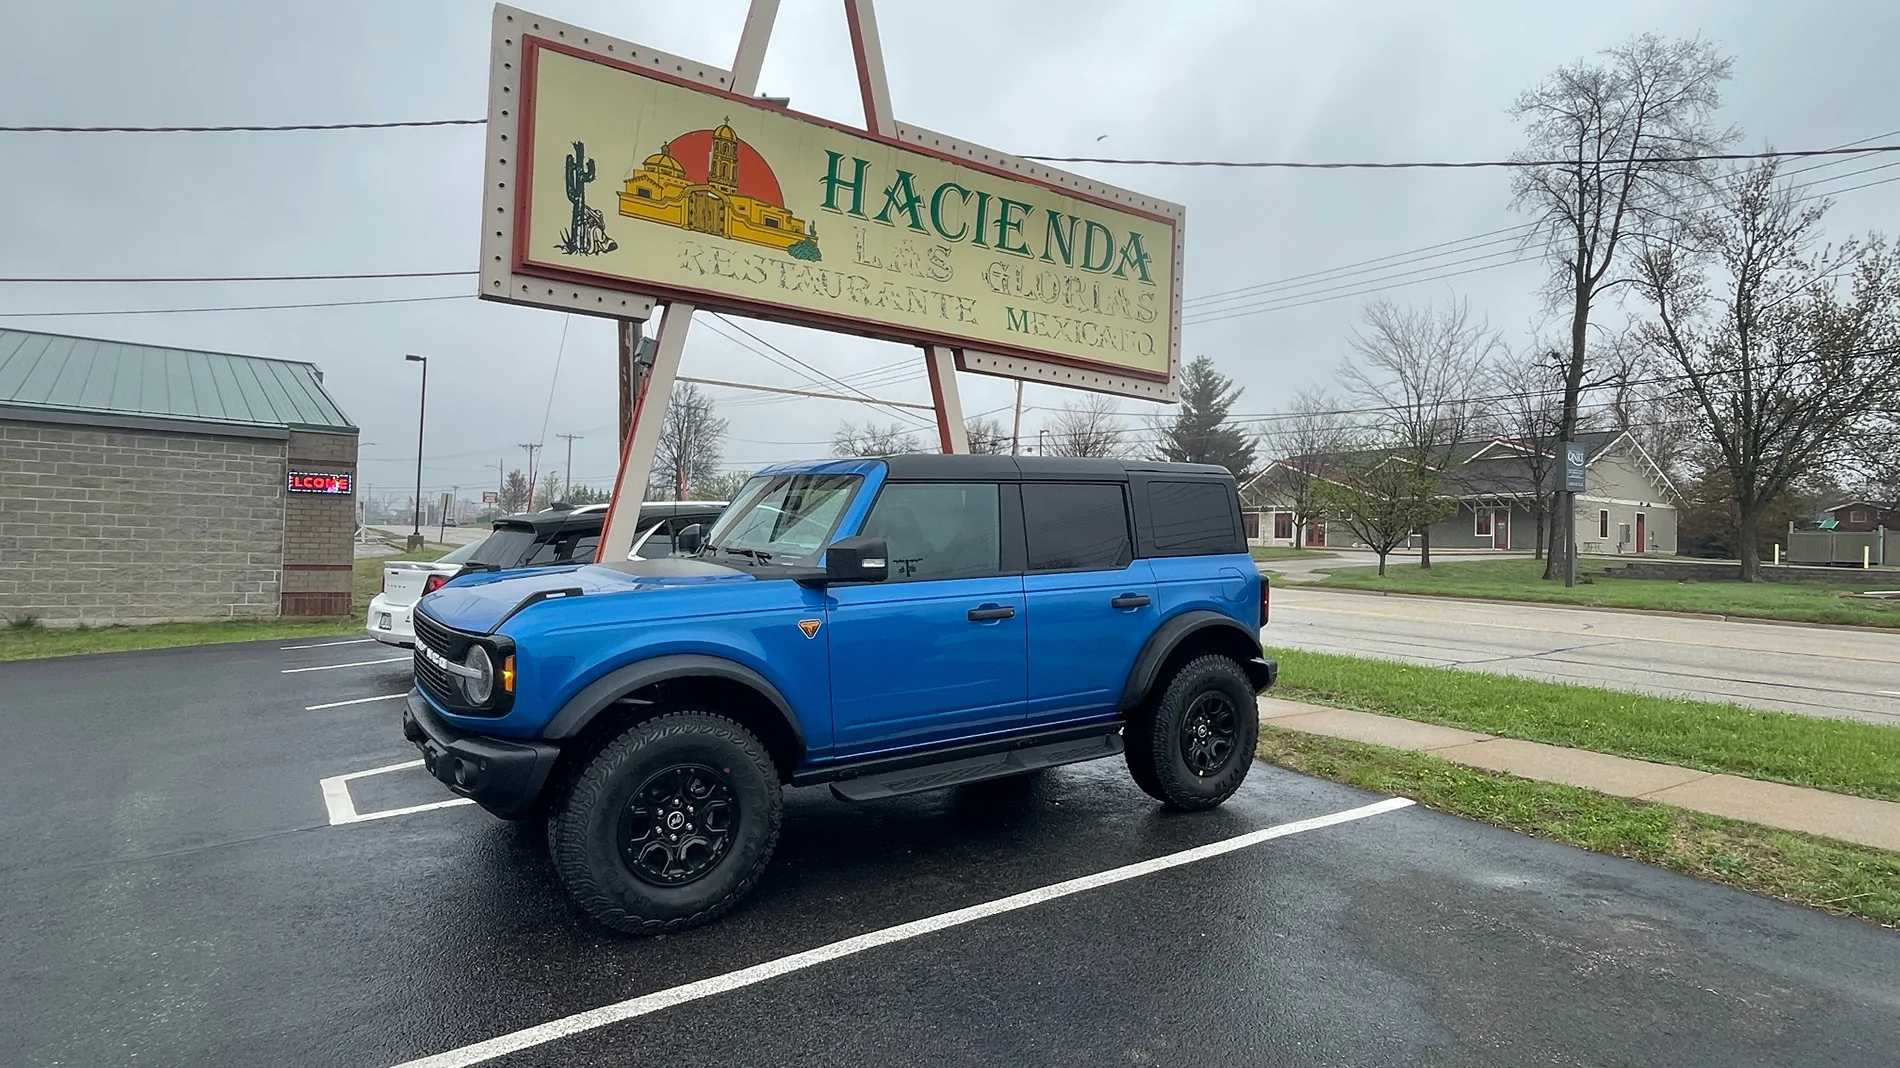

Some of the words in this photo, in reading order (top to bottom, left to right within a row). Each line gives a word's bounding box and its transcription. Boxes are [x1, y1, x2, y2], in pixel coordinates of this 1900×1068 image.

[819, 149, 1157, 287] HACIENDA
[678, 240, 979, 325] RESTAURANTE
[853, 226, 954, 282] LAS
[981, 261, 1159, 324] GLORIAS
